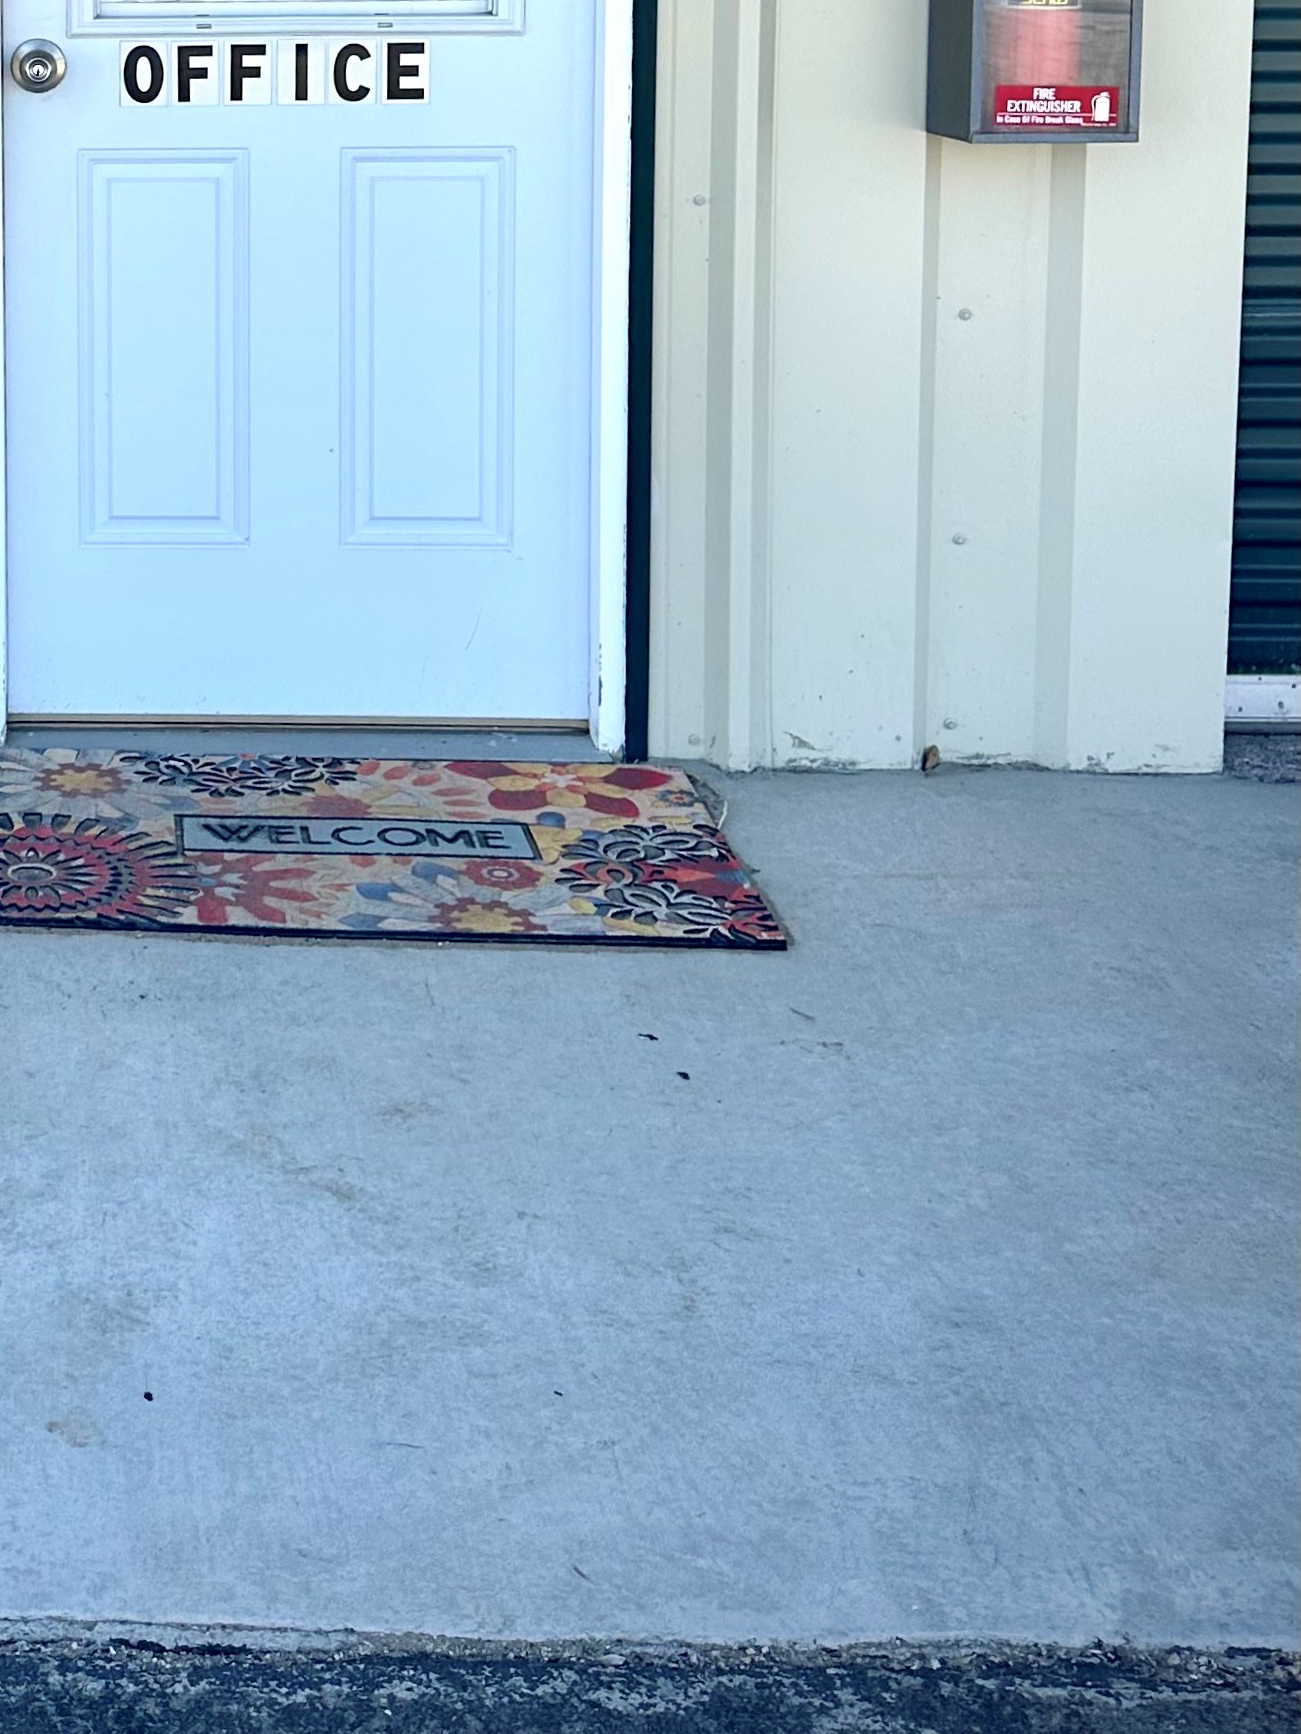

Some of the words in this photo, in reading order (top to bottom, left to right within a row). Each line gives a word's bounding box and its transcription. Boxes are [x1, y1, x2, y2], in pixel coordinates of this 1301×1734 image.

[123, 42, 426, 104] OFFICE
[1033, 87, 1057, 101] FIRE
[1006, 100, 1082, 113] EXTINGUISHER
[202, 822, 512, 850] WELCOME
